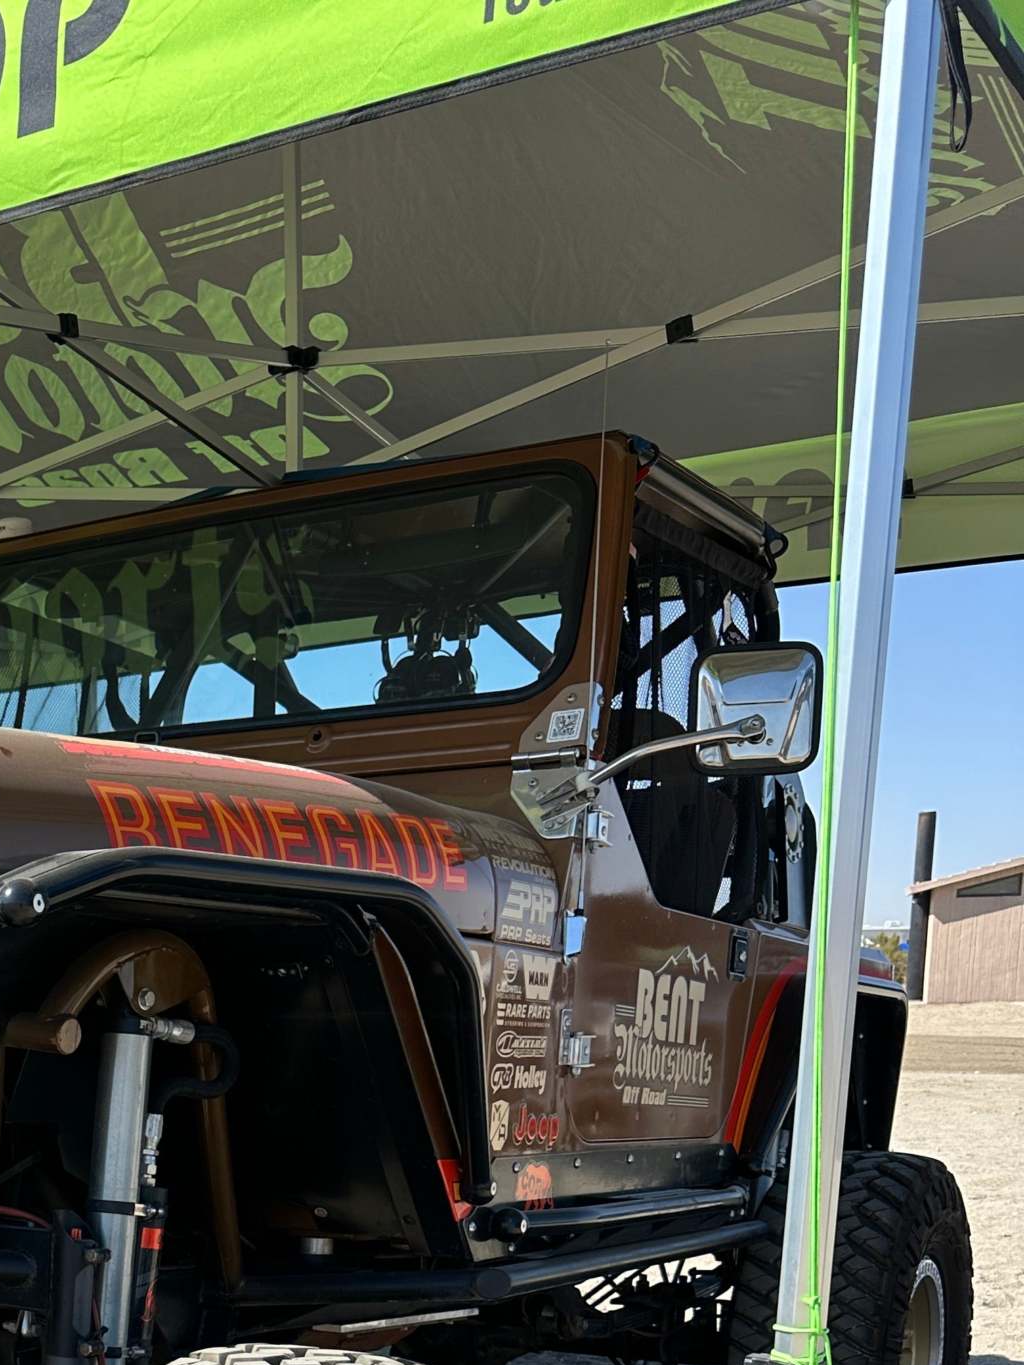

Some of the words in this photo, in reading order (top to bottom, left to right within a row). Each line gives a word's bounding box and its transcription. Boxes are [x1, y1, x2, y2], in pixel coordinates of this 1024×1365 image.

[86, 778, 468, 892] RENEGADE
[499, 924, 523, 941] PRP
[525, 928, 552, 946] Seats
[528, 970, 550, 988] WARN
[505, 1003, 528, 1018] RARE
[527, 1004, 551, 1020] PARTS
[514, 1064, 546, 1095] Holley
